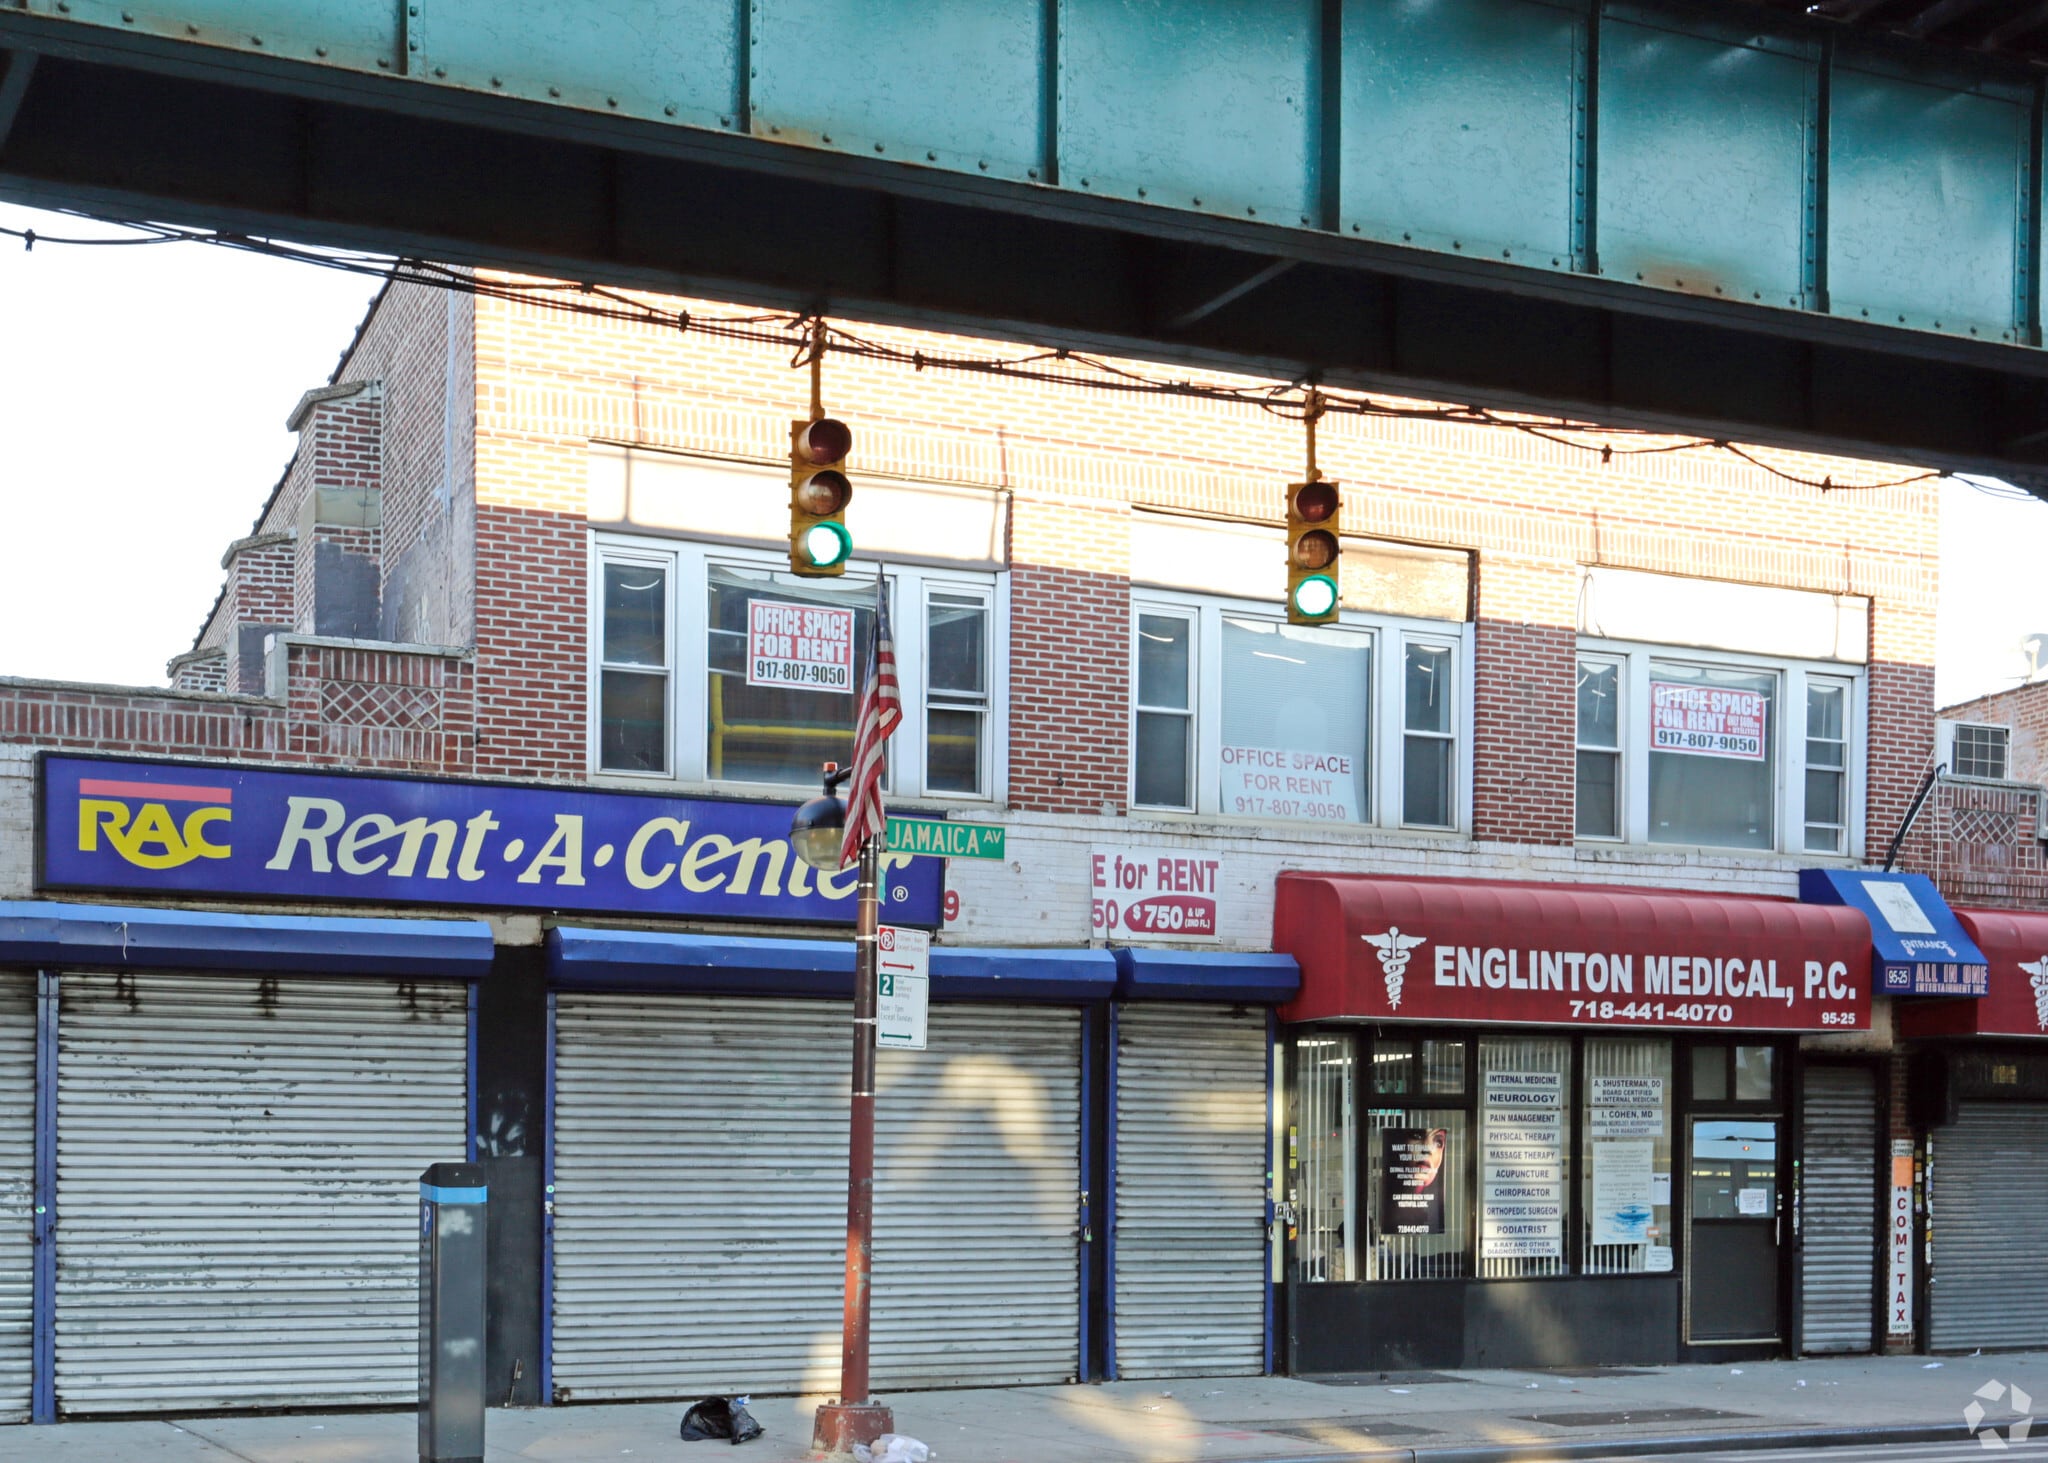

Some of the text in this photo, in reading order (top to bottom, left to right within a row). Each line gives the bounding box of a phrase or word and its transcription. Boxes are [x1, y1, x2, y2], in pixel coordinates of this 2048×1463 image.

[754, 606, 848, 640] OFFICE SPACE
[754, 633, 848, 663] FOR RENT
[757, 660, 845, 685] 917-807-9050
[1654, 686, 1761, 716] OFFICE SPACE
[1654, 706, 1684, 729] FOR
[1687, 710, 1726, 732] RENT
[1658, 730, 1757, 753] 917-807-9050
[1221, 747, 1351, 774] OFFICE SPACE
[1243, 773, 1333, 796] FOR RENT
[1235, 796, 1346, 820] 917-807-9050
[79, 799, 232, 869] RAC
[888, 823, 1002, 855] JAMAICA AV
[1114, 855, 1148, 890] for
[1157, 858, 1219, 893] RENT
[1132, 904, 1184, 929] $750
[1195, 908, 1206, 917] UP
[1900, 940, 1949, 949] ENTRANCE
[882, 976, 891, 994] 2
[1435, 945, 1856, 1007] ENGLINTON MEDICAL, P.C.
[1889, 970, 1908, 984] 95-25
[1915, 963, 1987, 985] ALL IN ONE
[1916, 983, 1971, 993] ENTERTAINMENT
[1569, 1000, 1733, 1022] 718-441-4070
[1822, 1012, 1856, 1025] 95-25
[1489, 1075, 1557, 1084] INTERNAL MEDICINE
[1489, 1094, 1556, 1103] NEUROLOGY
[1490, 1114, 1556, 1123] PAIN MANAGEMENT
[1608, 1110, 1639, 1119] COHEN,
[1489, 1132, 1556, 1141] PHYSICAL THERAPY
[1490, 1151, 1556, 1160] MASSAGE THERAPY
[1495, 1169, 1549, 1178] ACUPUNCTURE
[1494, 1188, 1550, 1197] CHIROPRACTOR
[423, 1205, 431, 1232] P
[1487, 1207, 1558, 1215] ORTHOPEDIC SURGEON
[1496, 1225, 1548, 1234] PODIATRIST
[1895, 1273, 1907, 1322] TAX
